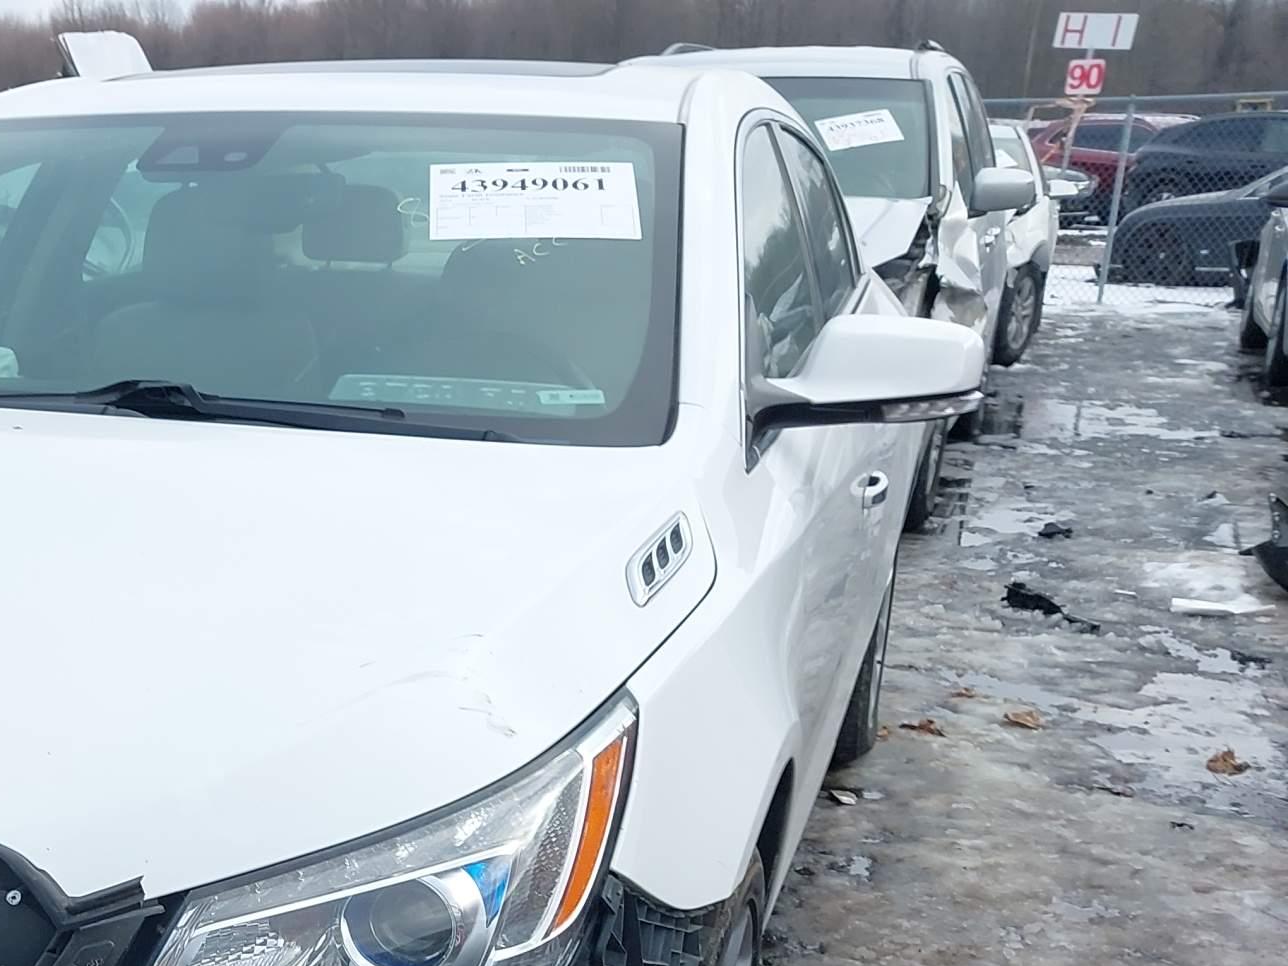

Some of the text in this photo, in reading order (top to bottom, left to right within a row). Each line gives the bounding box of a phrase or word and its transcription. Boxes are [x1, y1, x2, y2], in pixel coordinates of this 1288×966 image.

[1060, 15, 1088, 46] H
[1068, 63, 1105, 90] 90
[451, 177, 607, 193] 43949061
